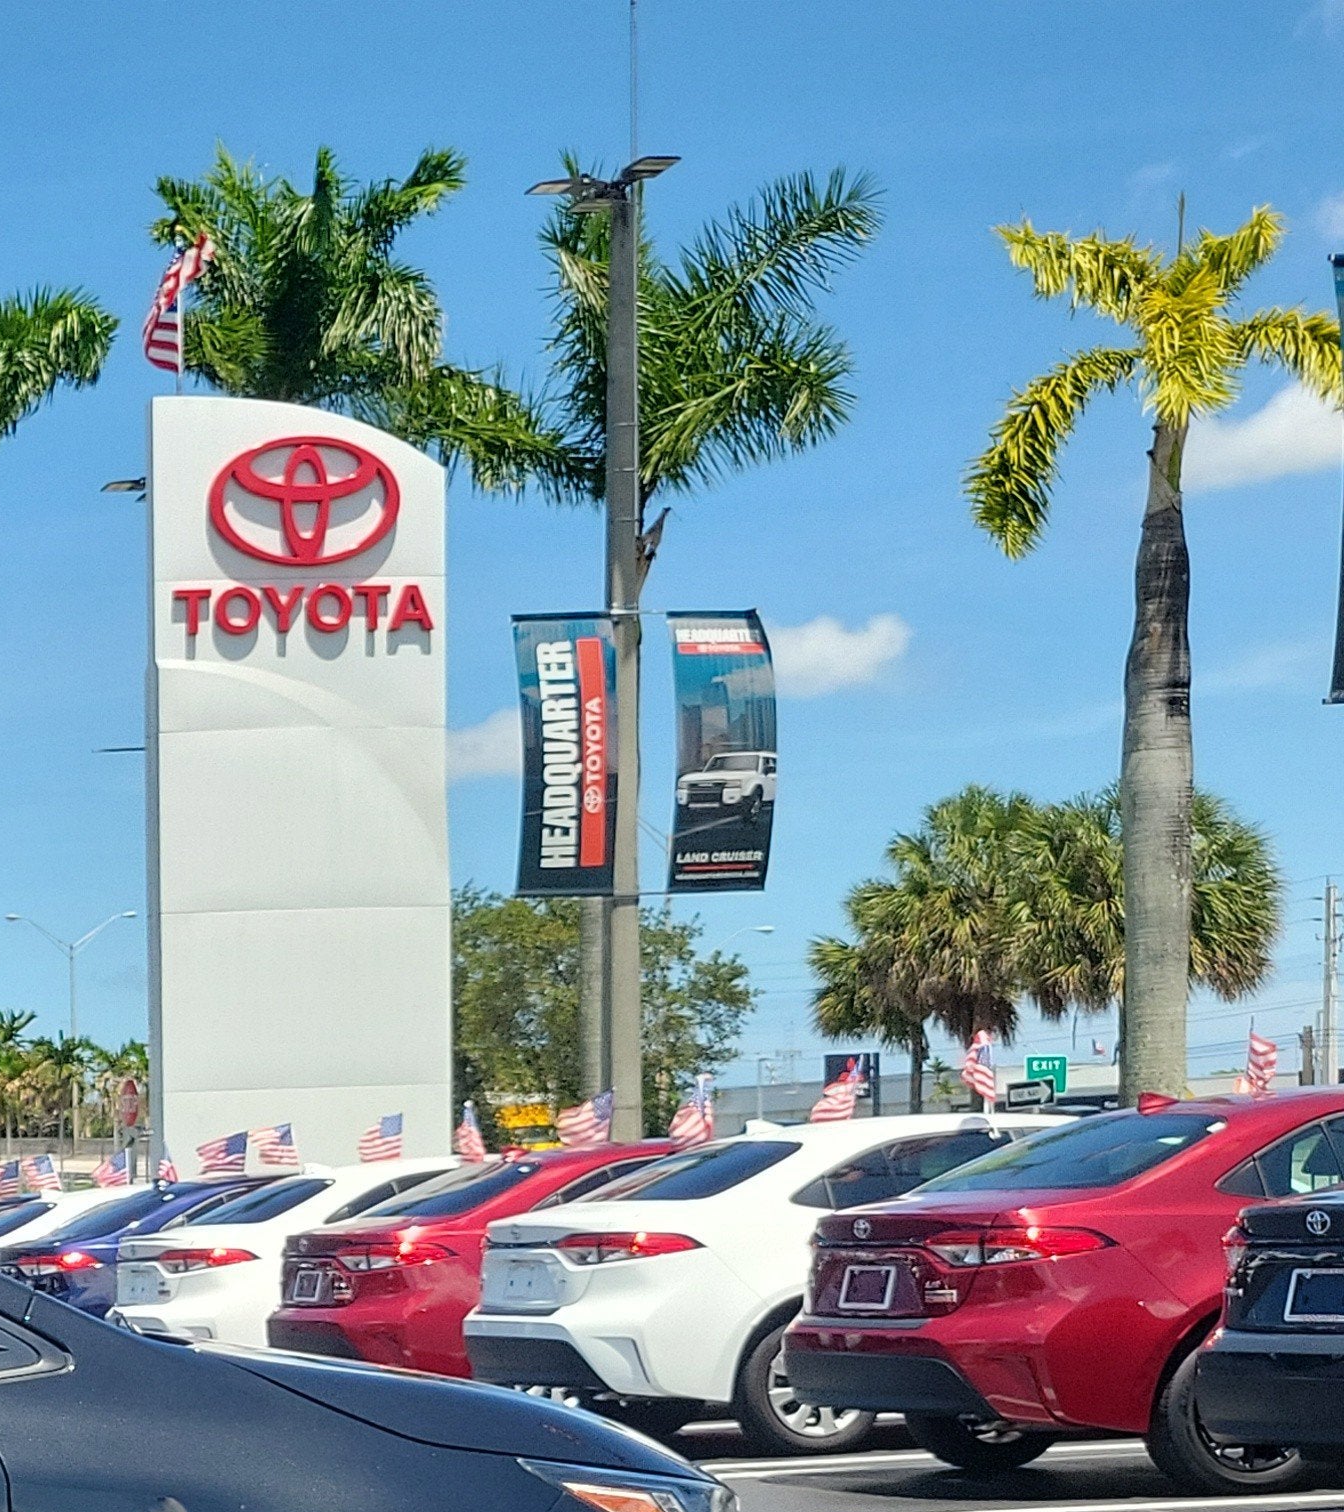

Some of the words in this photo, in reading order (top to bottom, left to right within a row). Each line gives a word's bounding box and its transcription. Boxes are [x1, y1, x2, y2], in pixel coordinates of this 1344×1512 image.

[172, 584, 434, 635] TOYOTA
[536, 641, 581, 869] HEADQUARTER
[585, 697, 603, 782] TOYOTA
[675, 852, 709, 863] LAND
[711, 850, 764, 862] CRUISER
[1032, 1060, 1060, 1071] EXIT
